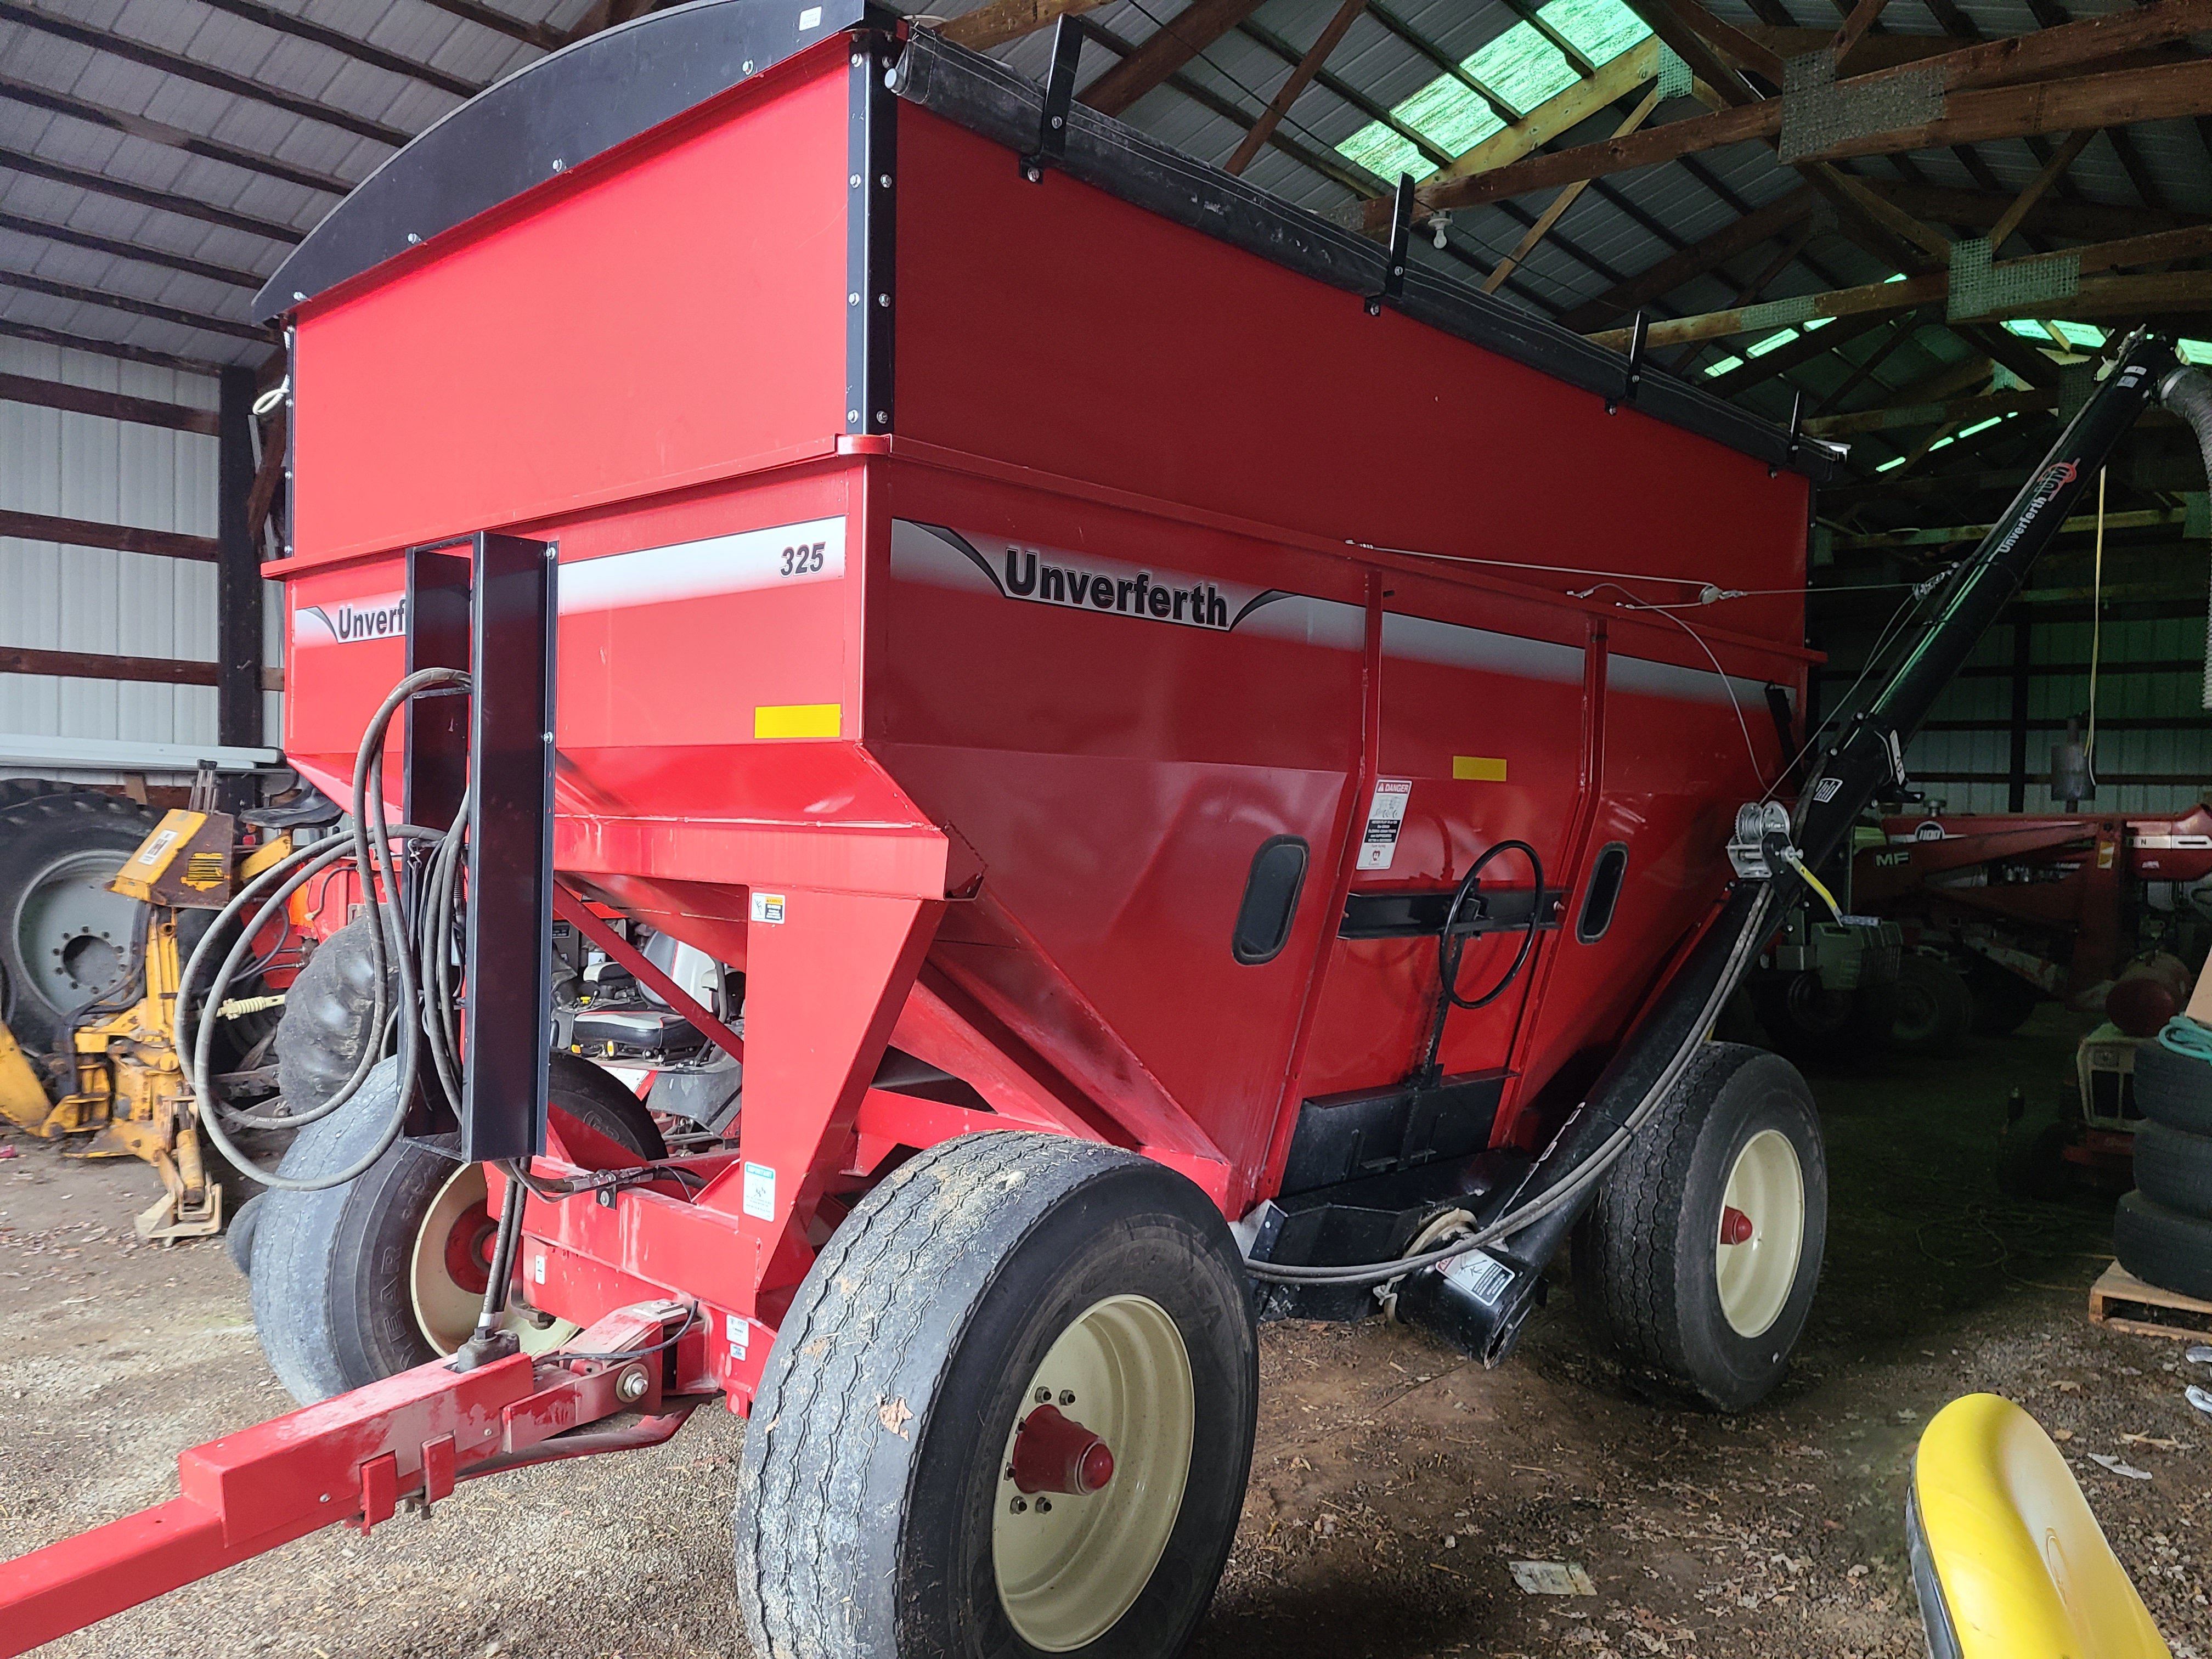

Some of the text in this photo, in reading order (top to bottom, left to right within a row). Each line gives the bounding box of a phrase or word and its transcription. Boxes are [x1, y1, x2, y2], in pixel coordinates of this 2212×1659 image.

[1998, 496, 2047, 554] Unverferth
[780, 541, 826, 577] 325
[1004, 547, 1228, 628] Unverferth
[1385, 783, 1409, 792] DANGER
[1918, 829, 1941, 840] 1100
[1875, 851, 1909, 867] MF
